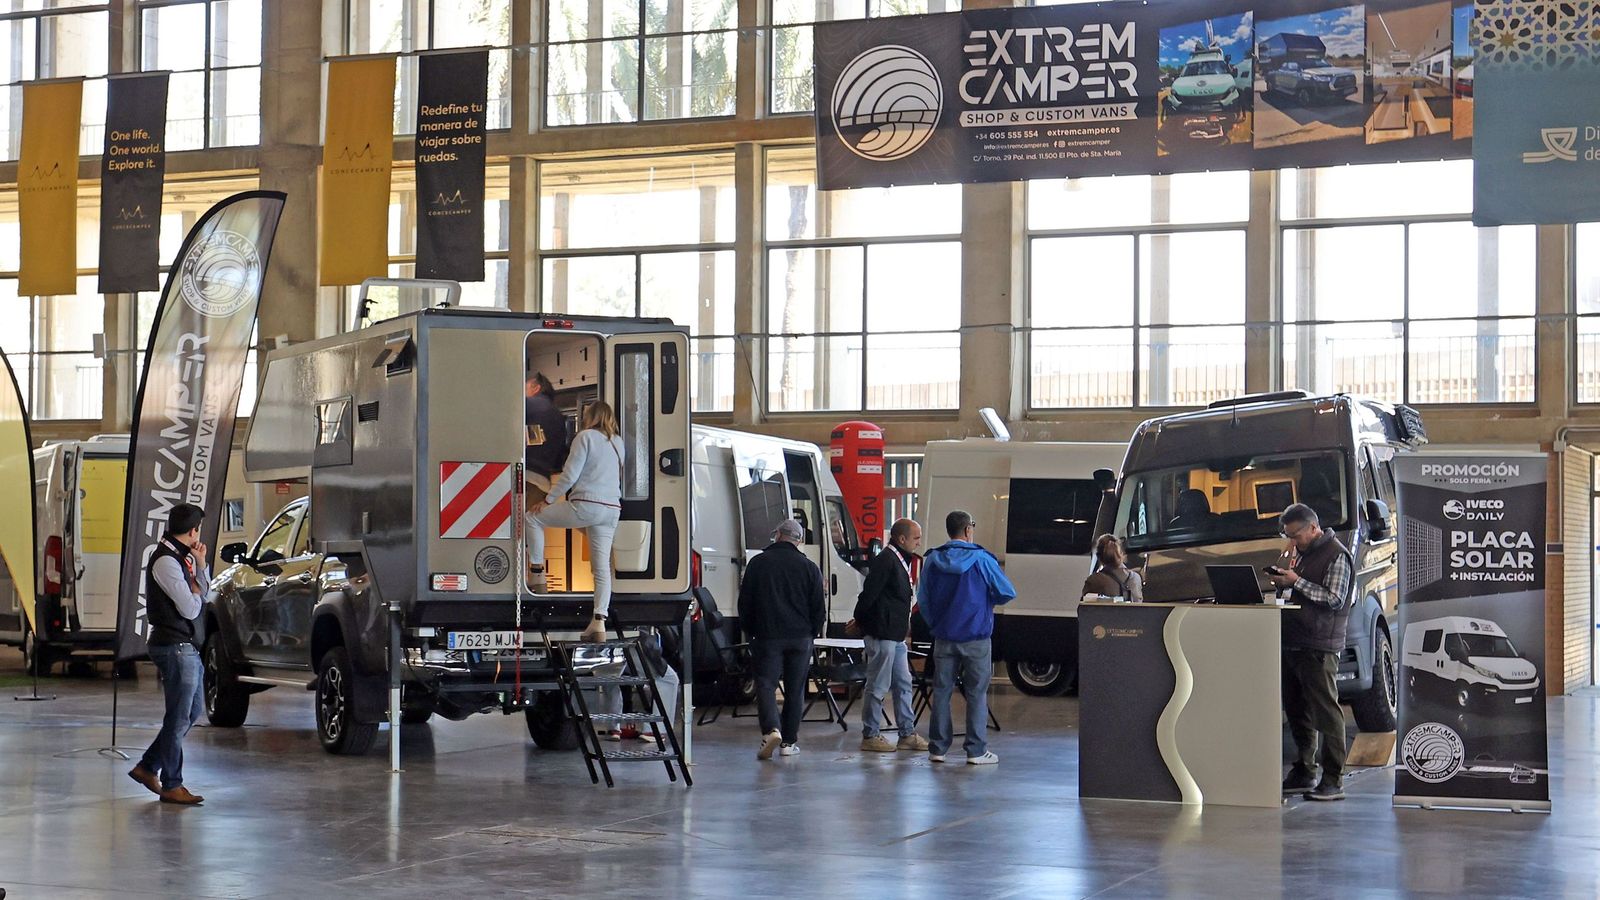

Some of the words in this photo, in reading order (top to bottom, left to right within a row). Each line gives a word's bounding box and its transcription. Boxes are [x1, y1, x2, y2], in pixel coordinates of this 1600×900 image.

[963, 21, 1136, 67] EXTREM
[958, 61, 1139, 105] CAMPER
[421, 104, 469, 116] Redefine
[471, 102, 483, 113] tu
[966, 113, 1004, 124] SHOP
[1010, 111, 1019, 122] &
[1025, 108, 1085, 121] CUSTOM
[1091, 106, 1128, 118] VANS
[420, 121, 462, 131] manera
[464, 117, 478, 128] de
[110, 130, 131, 141] One
[132, 128, 151, 140] life.
[989, 132, 1006, 140] 605
[1007, 131, 1023, 139] 555
[1024, 130, 1038, 138] 554
[1047, 126, 1121, 138] extremcamper.es
[419, 136, 450, 149] viajar
[451, 133, 482, 145] sobre
[1067, 139, 1111, 147] extremcamper
[109, 145, 130, 156] One
[131, 143, 162, 154] world.
[419, 150, 459, 163] ruedas.
[1080, 150, 1089, 158] de
[108, 160, 145, 172] Explore
[146, 158, 156, 168] it.
[201, 302, 233, 313] CUSTOM
[189, 445, 210, 505] USTOM
[200, 393, 219, 438] VANS
[1421, 461, 1520, 477] PROMOCIÓN
[1470, 477, 1492, 485] FERIA
[1466, 499, 1504, 509] IVECO
[1466, 512, 1505, 521] DAILY
[1451, 530, 1535, 549] PLACA
[1450, 550, 1534, 569] SOLAR
[1450, 570, 1535, 582] +INSTALACIÓN
[457, 634, 491, 647] 7629
[1404, 725, 1461, 755] EXTREMCAMPER
